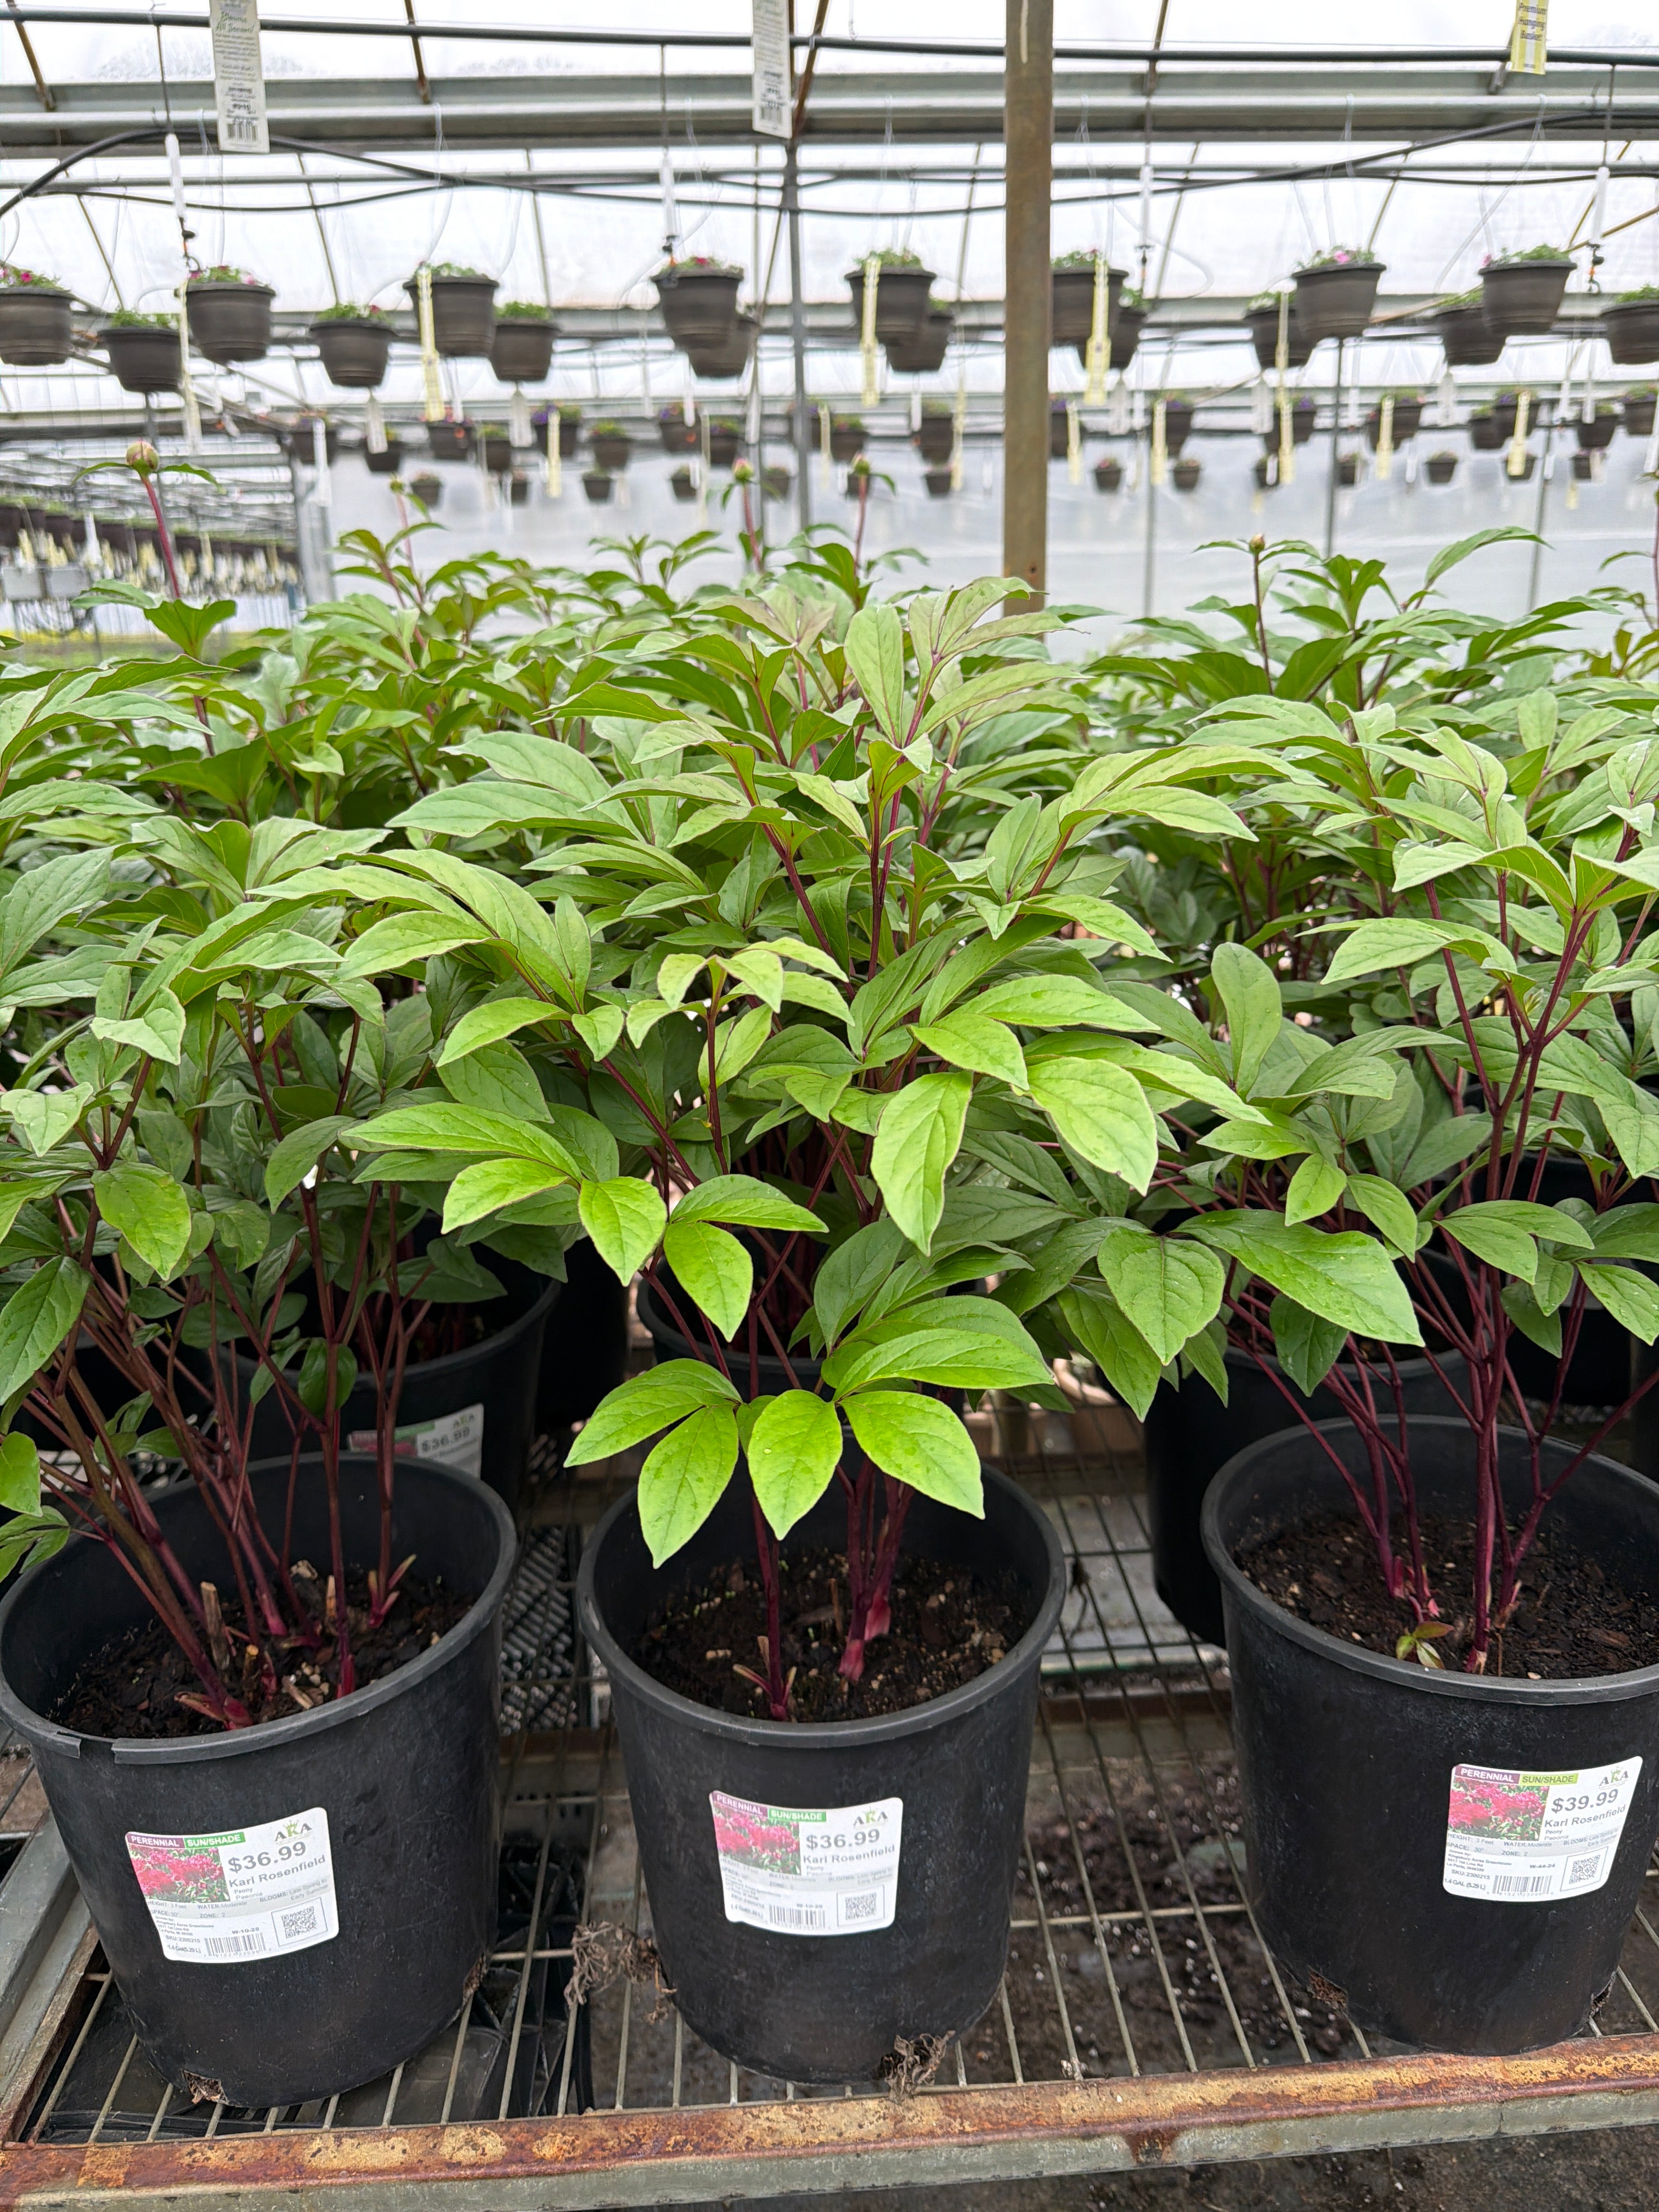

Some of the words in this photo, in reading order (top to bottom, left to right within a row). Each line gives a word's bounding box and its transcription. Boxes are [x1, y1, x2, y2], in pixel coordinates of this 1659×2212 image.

[1460, 1768, 1514, 1782] PERENNIAL
[1522, 1775, 1573, 1784] SUN/SHADE
[1599, 1769, 1629, 1786] AKA
[716, 1794, 763, 1815] PERENNIAL
[771, 1810, 822, 1820] SUN/SHADE
[1551, 1788, 1618, 1814] $39.99
[854, 1810, 888, 1826] AKA
[1544, 1819, 1568, 1827] Karl
[1571, 1804, 1626, 1825] Rosenfield
[131, 1835, 180, 1847] PERENNIAL
[187, 1834, 241, 1847] SUN/SHADE
[275, 1821, 312, 1842] AKA
[806, 1829, 880, 1850] $36.99
[228, 1841, 306, 1874] $36.99
[803, 1855, 827, 1864] Karl
[832, 1844, 895, 1863] Rosenfield
[229, 1876, 255, 1887] Karl
[259, 1855, 325, 1882] Rosenfield
[236, 1892, 263, 1900] Paeonia
